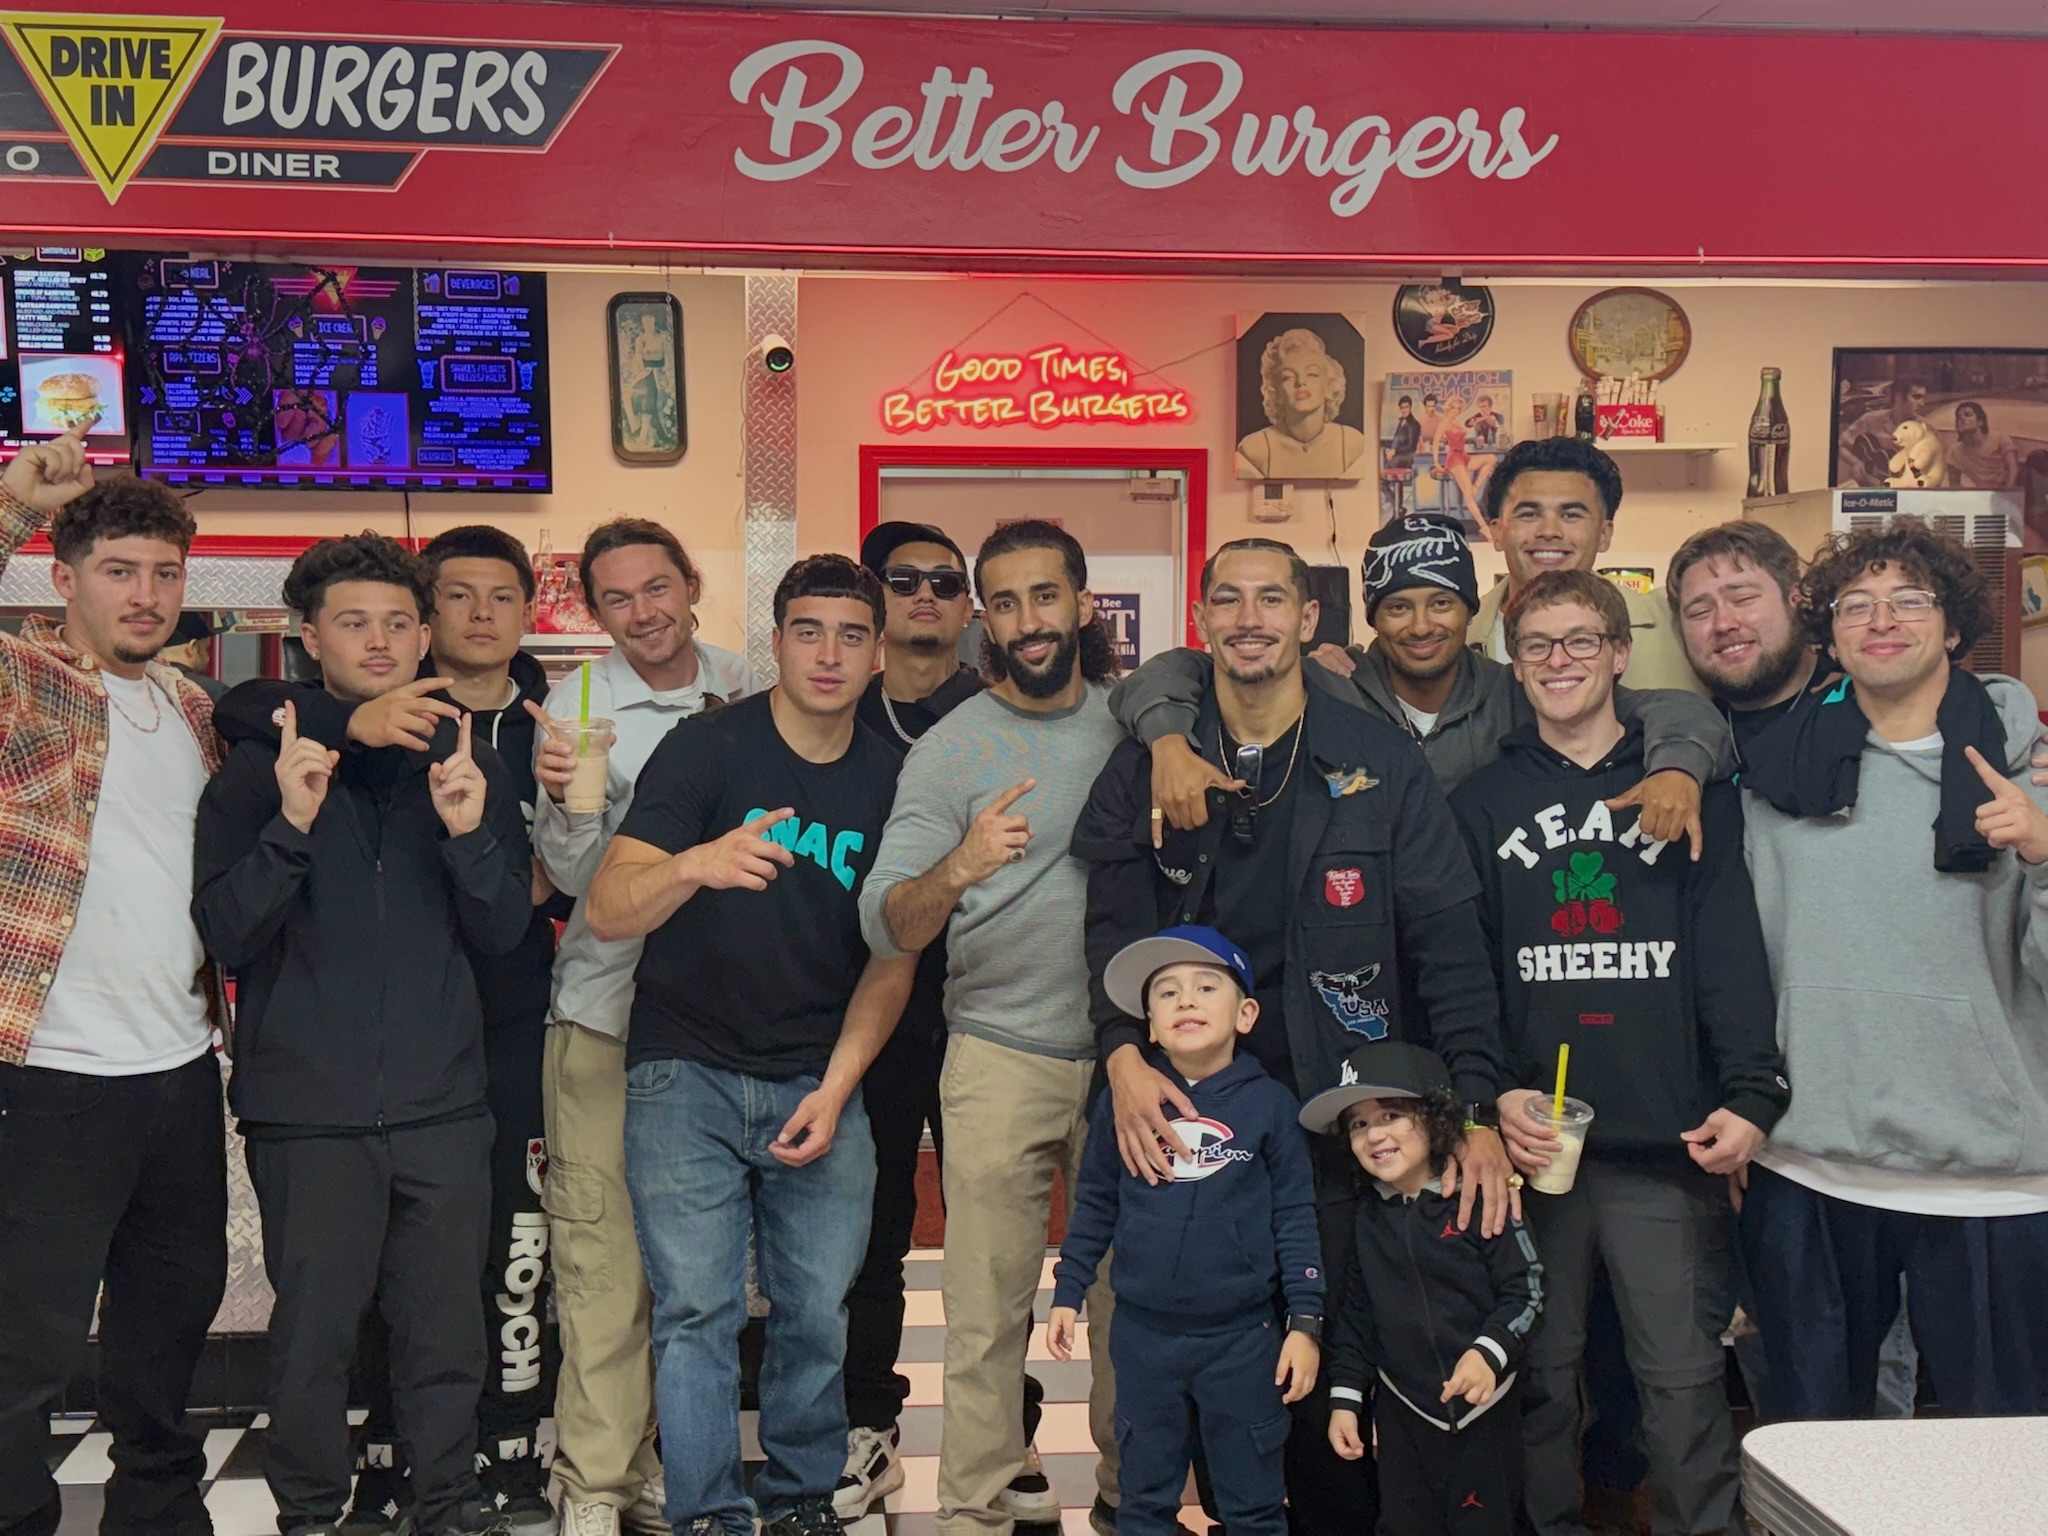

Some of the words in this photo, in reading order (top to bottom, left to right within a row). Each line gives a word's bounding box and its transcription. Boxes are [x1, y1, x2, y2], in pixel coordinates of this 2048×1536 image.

[50, 35, 171, 80] DRIVE
[223, 41, 547, 136] BURGERS
[91, 85, 135, 127] IN
[729, 39, 1100, 182] Better
[1112, 49, 1560, 218] Burgers
[207, 150, 341, 180] DINER
[450, 278, 496, 290] BEVERAGES
[319, 322, 332, 334] ICE
[333, 322, 354, 334] CREA
[168, 352, 218, 364] APTIZERS
[935, 353, 1023, 392] GOOD
[1030, 347, 1128, 386] TIMES,
[884, 393, 1025, 429] BETTER
[1030, 390, 1188, 425] BURGERS
[1618, 413, 1653, 429] Coke
[1843, 497, 1895, 509] Ice-O-Matic
[1102, 598, 1122, 608] Bee
[1517, 941, 1676, 982] SHEEHY
[1340, 996, 1390, 1018] USA
[1339, 1059, 1359, 1087] LA
